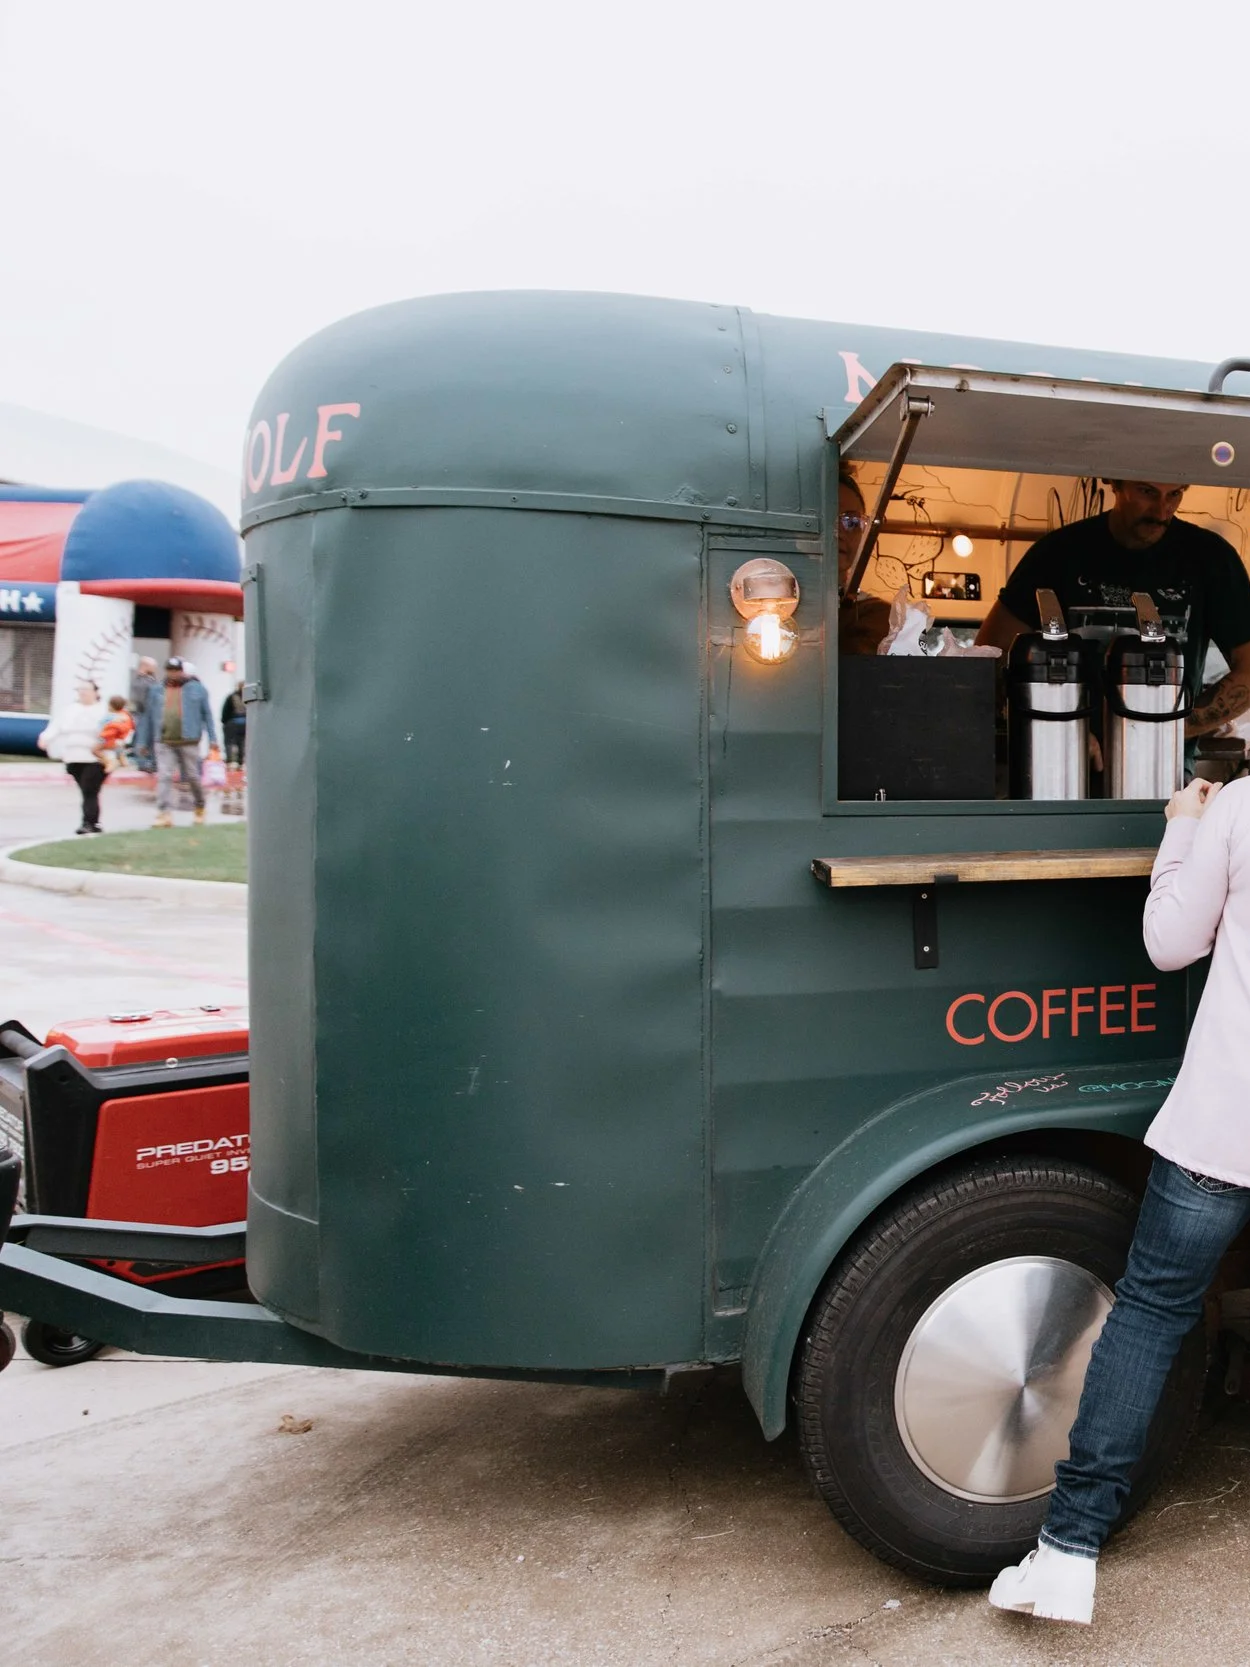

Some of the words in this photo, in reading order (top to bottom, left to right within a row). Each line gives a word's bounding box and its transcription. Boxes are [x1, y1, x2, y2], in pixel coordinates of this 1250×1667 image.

[243, 402, 361, 499] OLF
[946, 983, 1157, 1046] COFFEE
[1079, 1077, 1177, 1093] @MOON
[136, 1134, 250, 1161] PREDAT
[136, 1158, 181, 1170] SUPER
[184, 1151, 222, 1163] QUIET
[210, 1155, 250, 1175] 95
